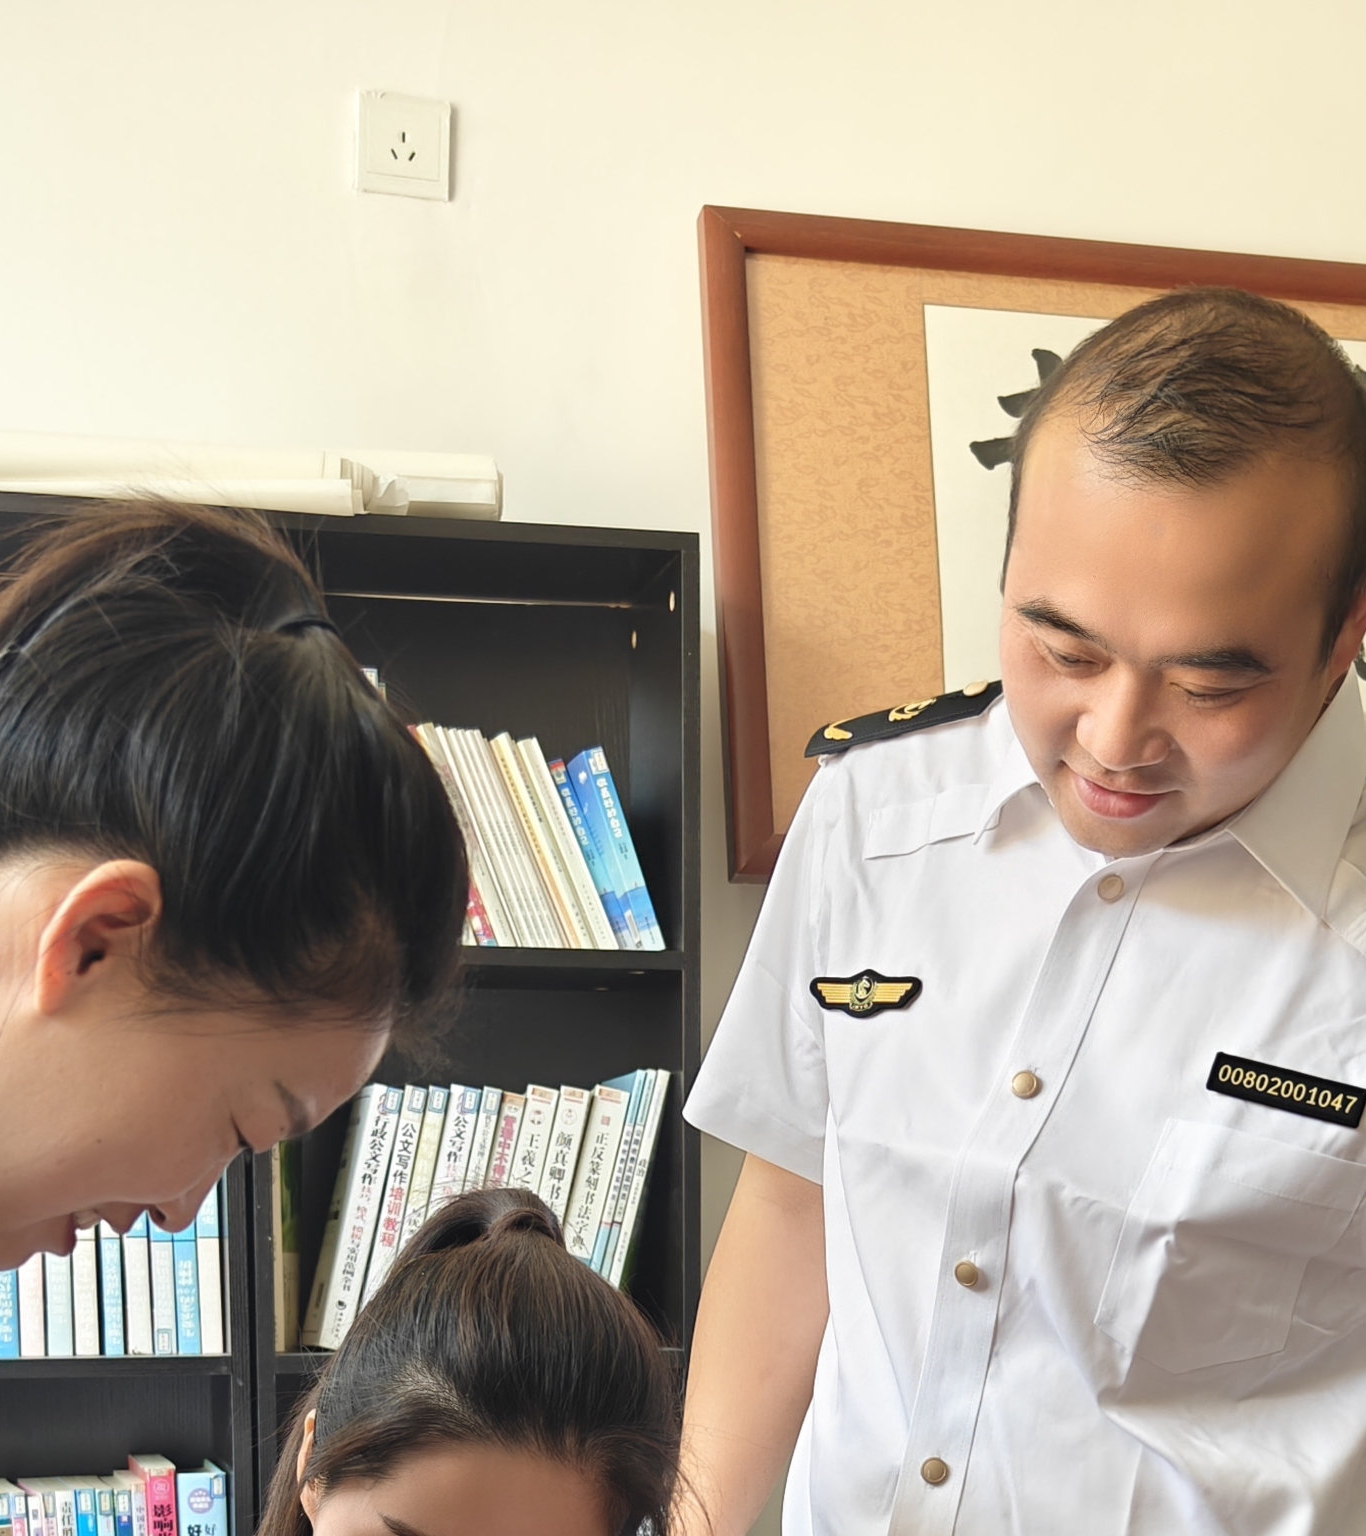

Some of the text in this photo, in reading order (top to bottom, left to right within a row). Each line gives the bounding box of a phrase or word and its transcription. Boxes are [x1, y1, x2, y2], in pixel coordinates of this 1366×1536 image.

[1218, 1064, 1357, 1115] 00802001047
[380, 1121, 418, 1248] 公文写作培训教程
[514, 1132, 542, 1186] 王羲之
